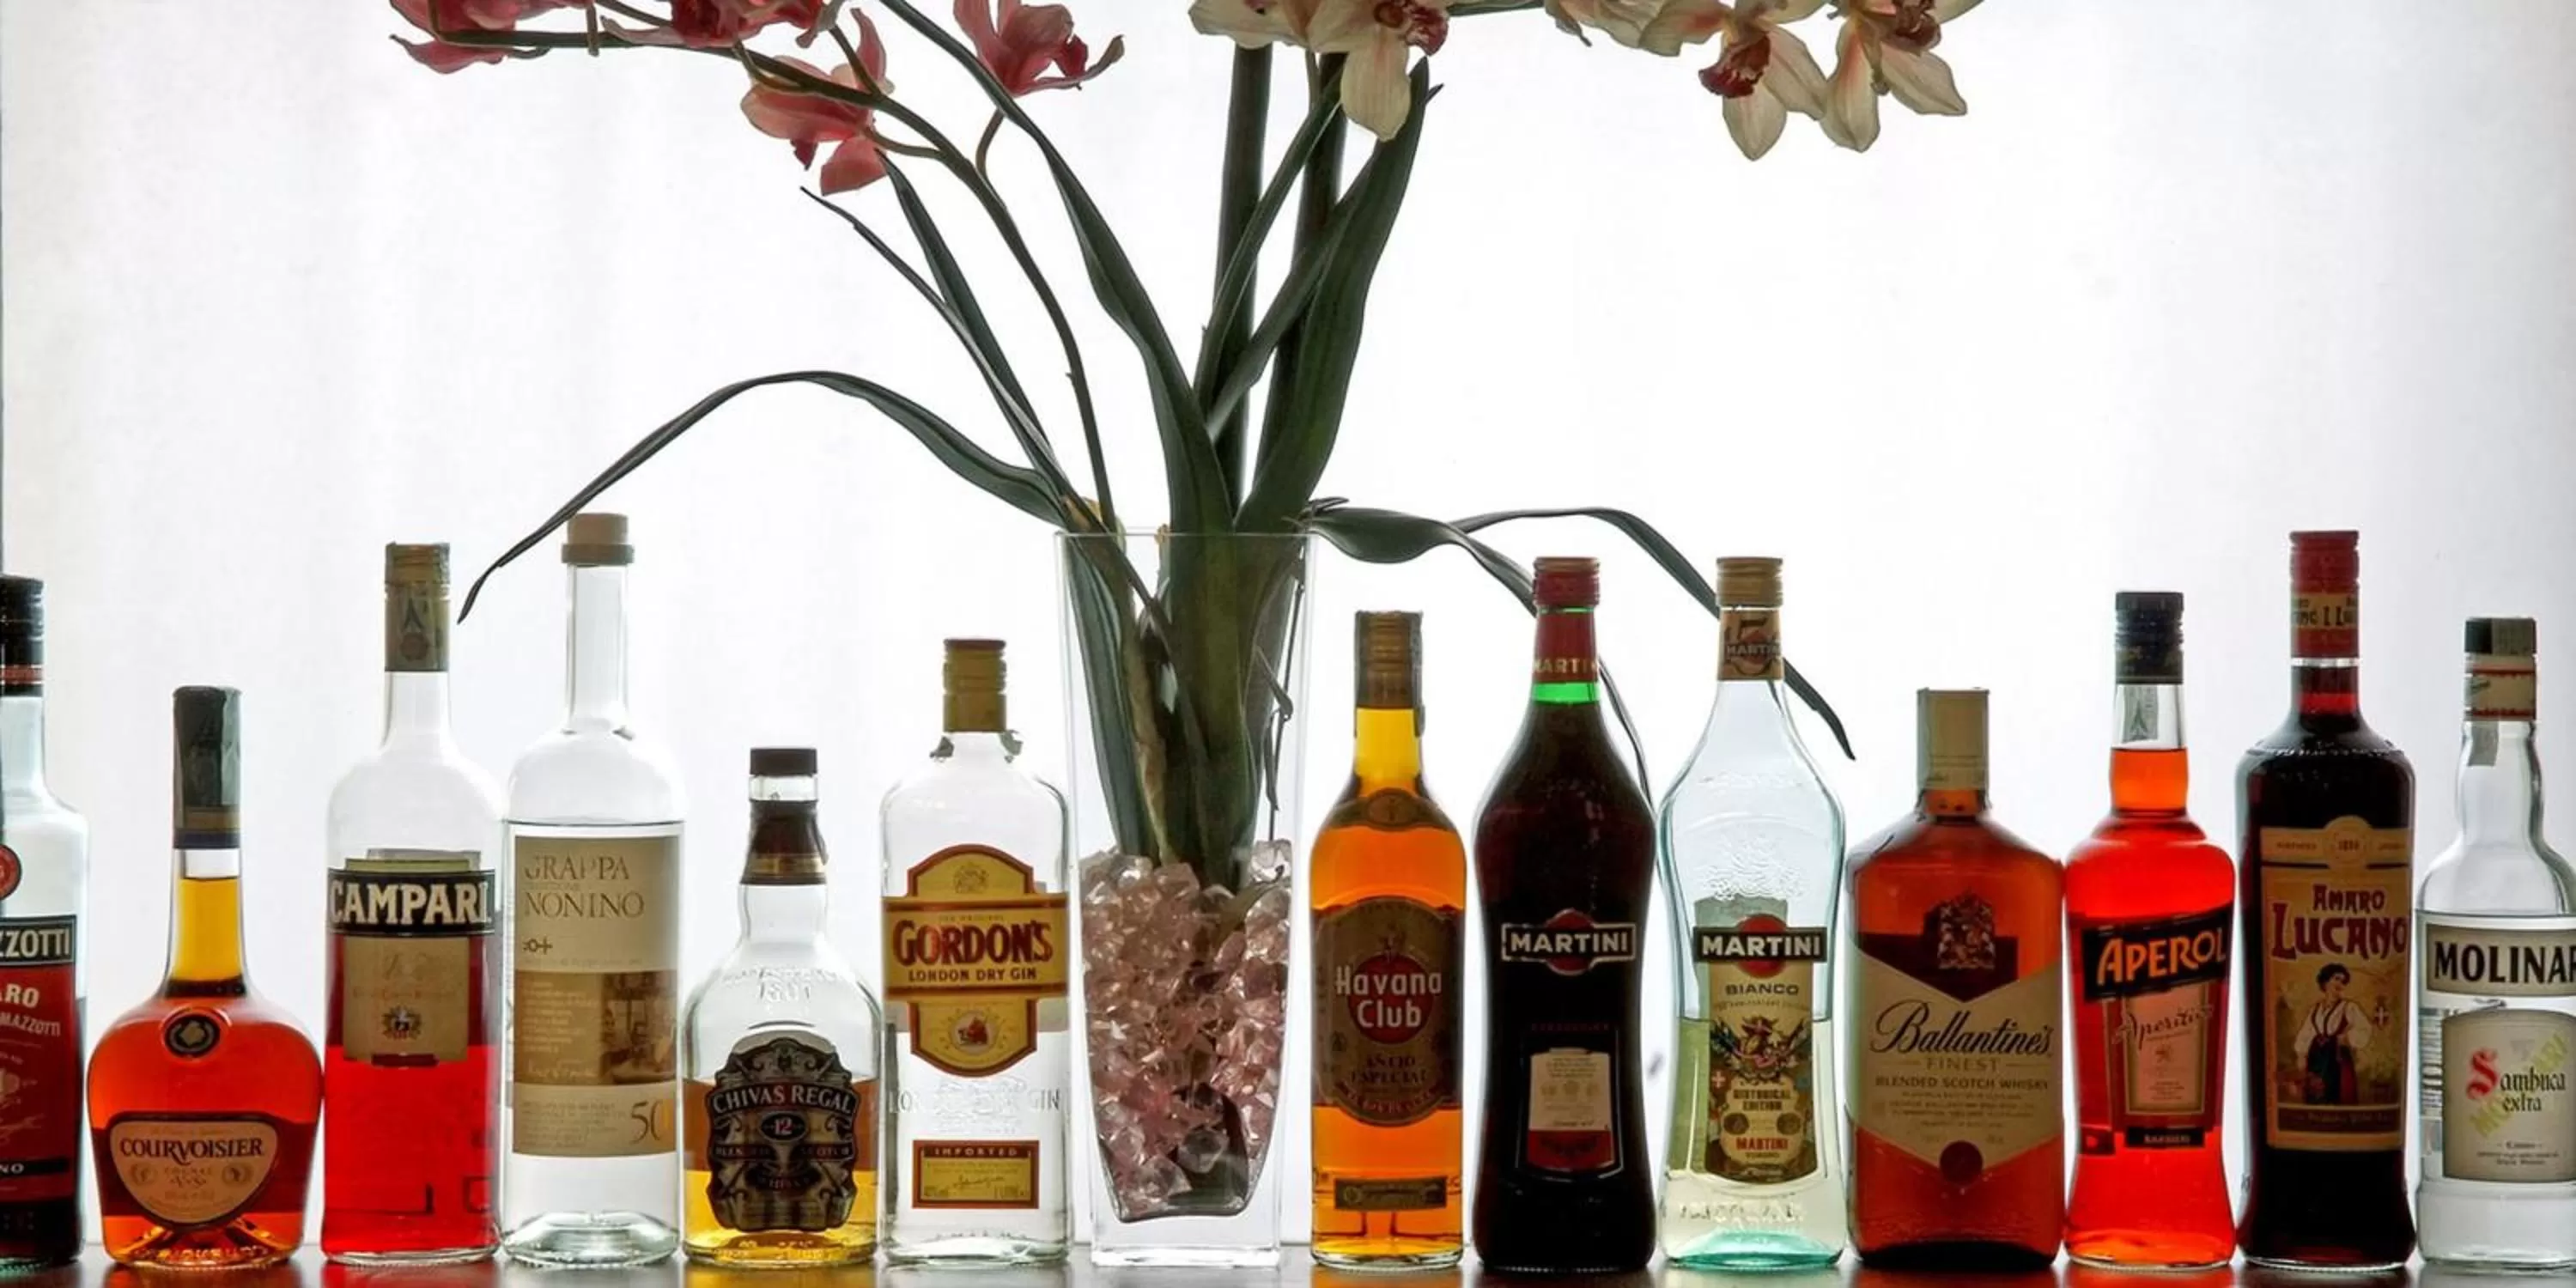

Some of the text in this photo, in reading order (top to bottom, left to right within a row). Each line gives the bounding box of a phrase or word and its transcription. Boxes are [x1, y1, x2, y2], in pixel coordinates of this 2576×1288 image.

[331, 880, 488, 925] CAMPARI
[525, 890, 645, 918] NONINO
[893, 920, 1054, 966] GORDON'S
[1510, 933, 1628, 953] MARTINI
[1702, 935, 1821, 957] MARTINI
[2097, 927, 2227, 986] APEROL
[908, 967, 1037, 982] LONDON DRY GIN
[1335, 965, 1442, 995] Havana
[0, 982, 39, 1008] RO
[1725, 984, 1799, 995] BIANCO
[1357, 1000, 1422, 1028] Club
[1869, 999, 2054, 1055] Ballantine's
[1926, 1058, 2001, 1071] FINEST
[2466, 1048, 2566, 1100] Sambuca
[1875, 1075, 1938, 1088] BLENDED
[1943, 1078, 1995, 1089] SCOTCH
[713, 1084, 786, 1114] CHIVAS
[791, 1084, 853, 1115] REGAL
[2502, 1093, 2543, 1113] extra
[775, 1116, 793, 1136] 12
[119, 1138, 264, 1165] COURVOISIER
[934, 1146, 1018, 1157] IMPORTED
